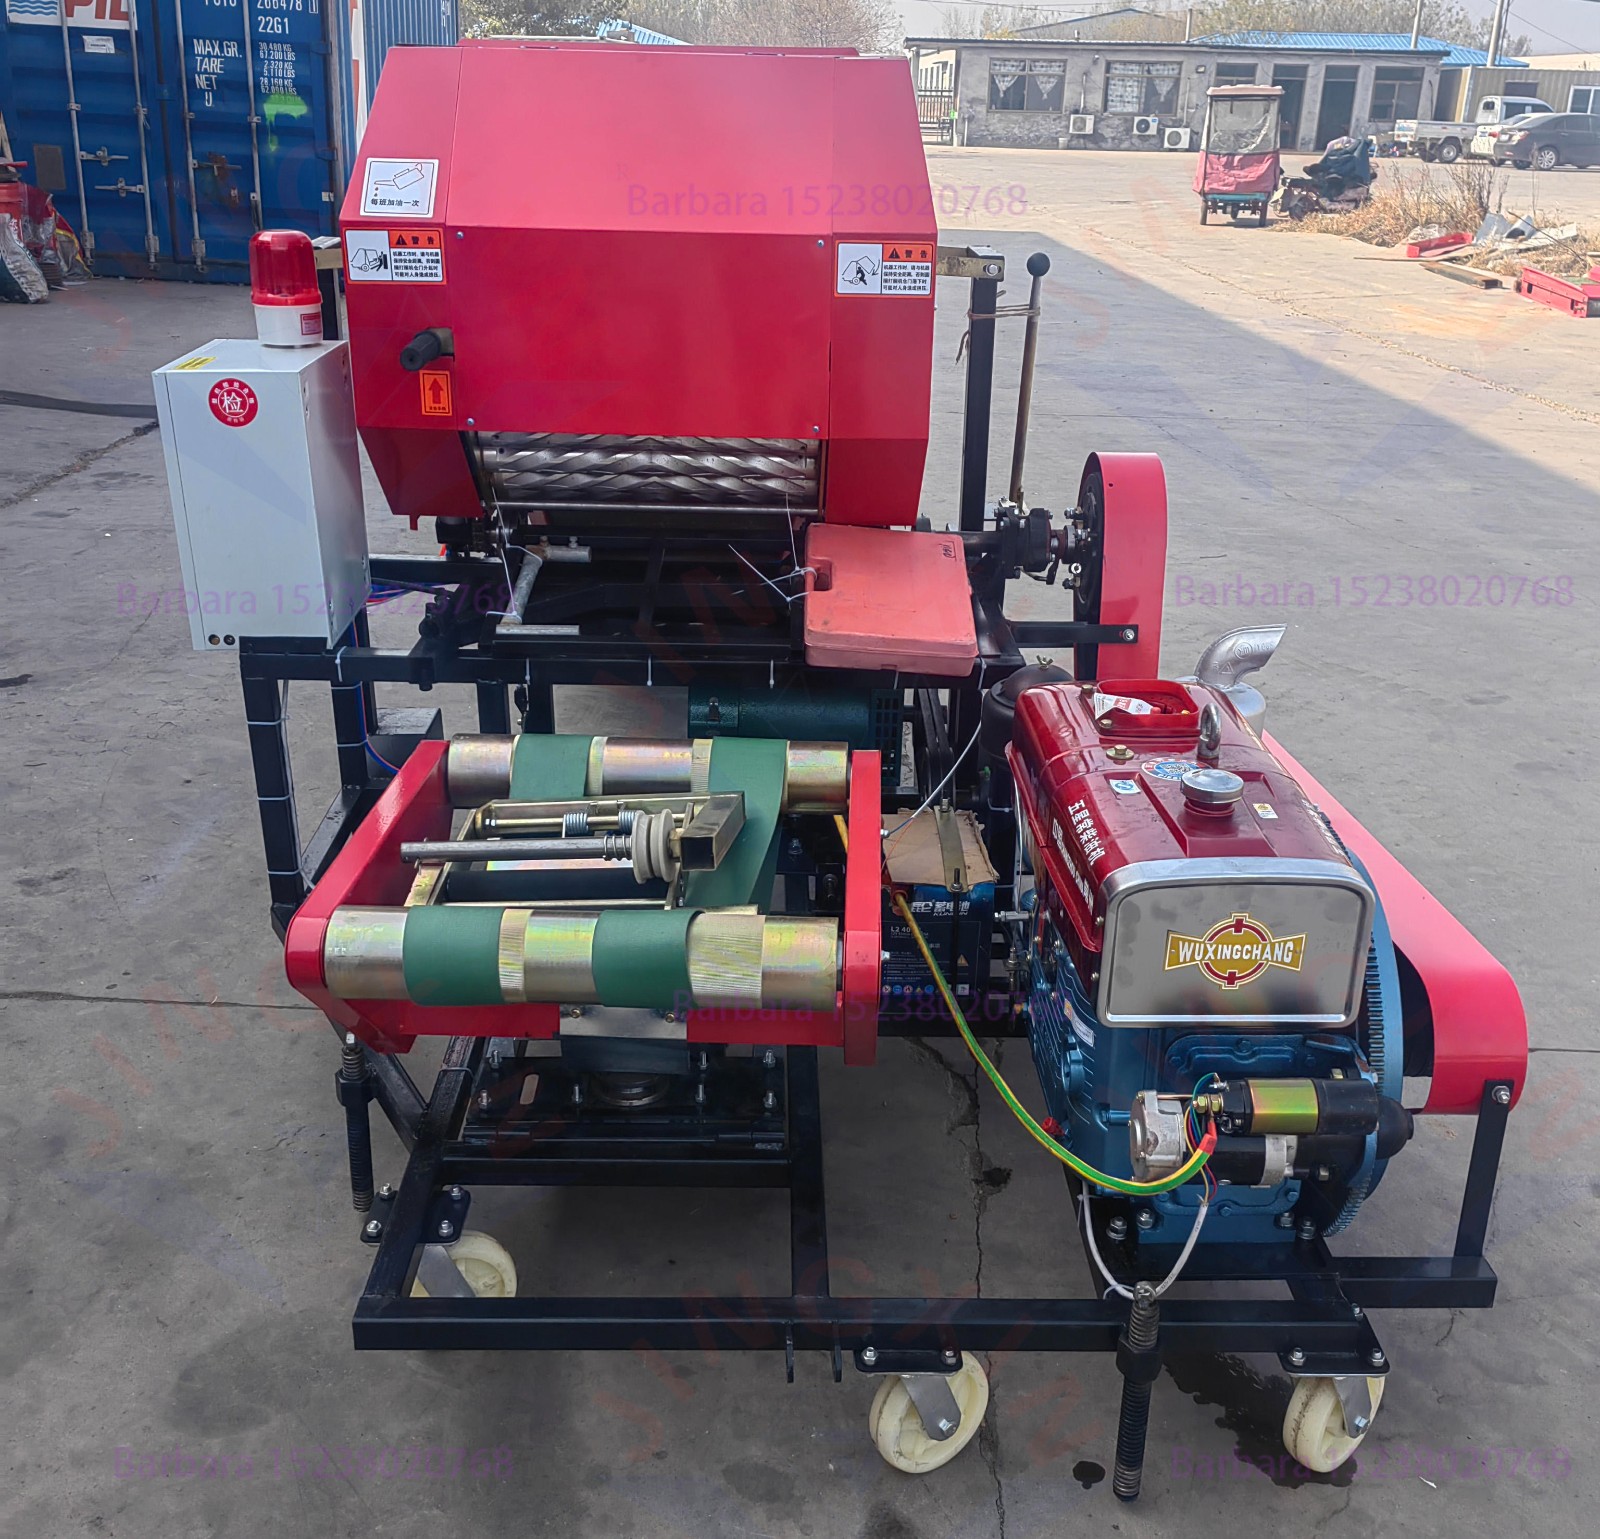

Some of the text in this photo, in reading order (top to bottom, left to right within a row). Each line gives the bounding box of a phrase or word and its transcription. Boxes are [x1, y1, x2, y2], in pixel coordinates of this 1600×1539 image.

[258, 16, 289, 34] 22G1
[193, 38, 242, 58] MAX.GR.
[284, 52, 296, 61] LBS
[195, 56, 224, 73] TARE
[284, 61, 293, 70] KG
[194, 73, 217, 90] NET
[284, 70, 295, 78] LBS
[370, 198, 419, 206] 每班加油一次
[221, 391, 243, 413] 检
[1178, 940, 1294, 964] WUXINGCHANG
